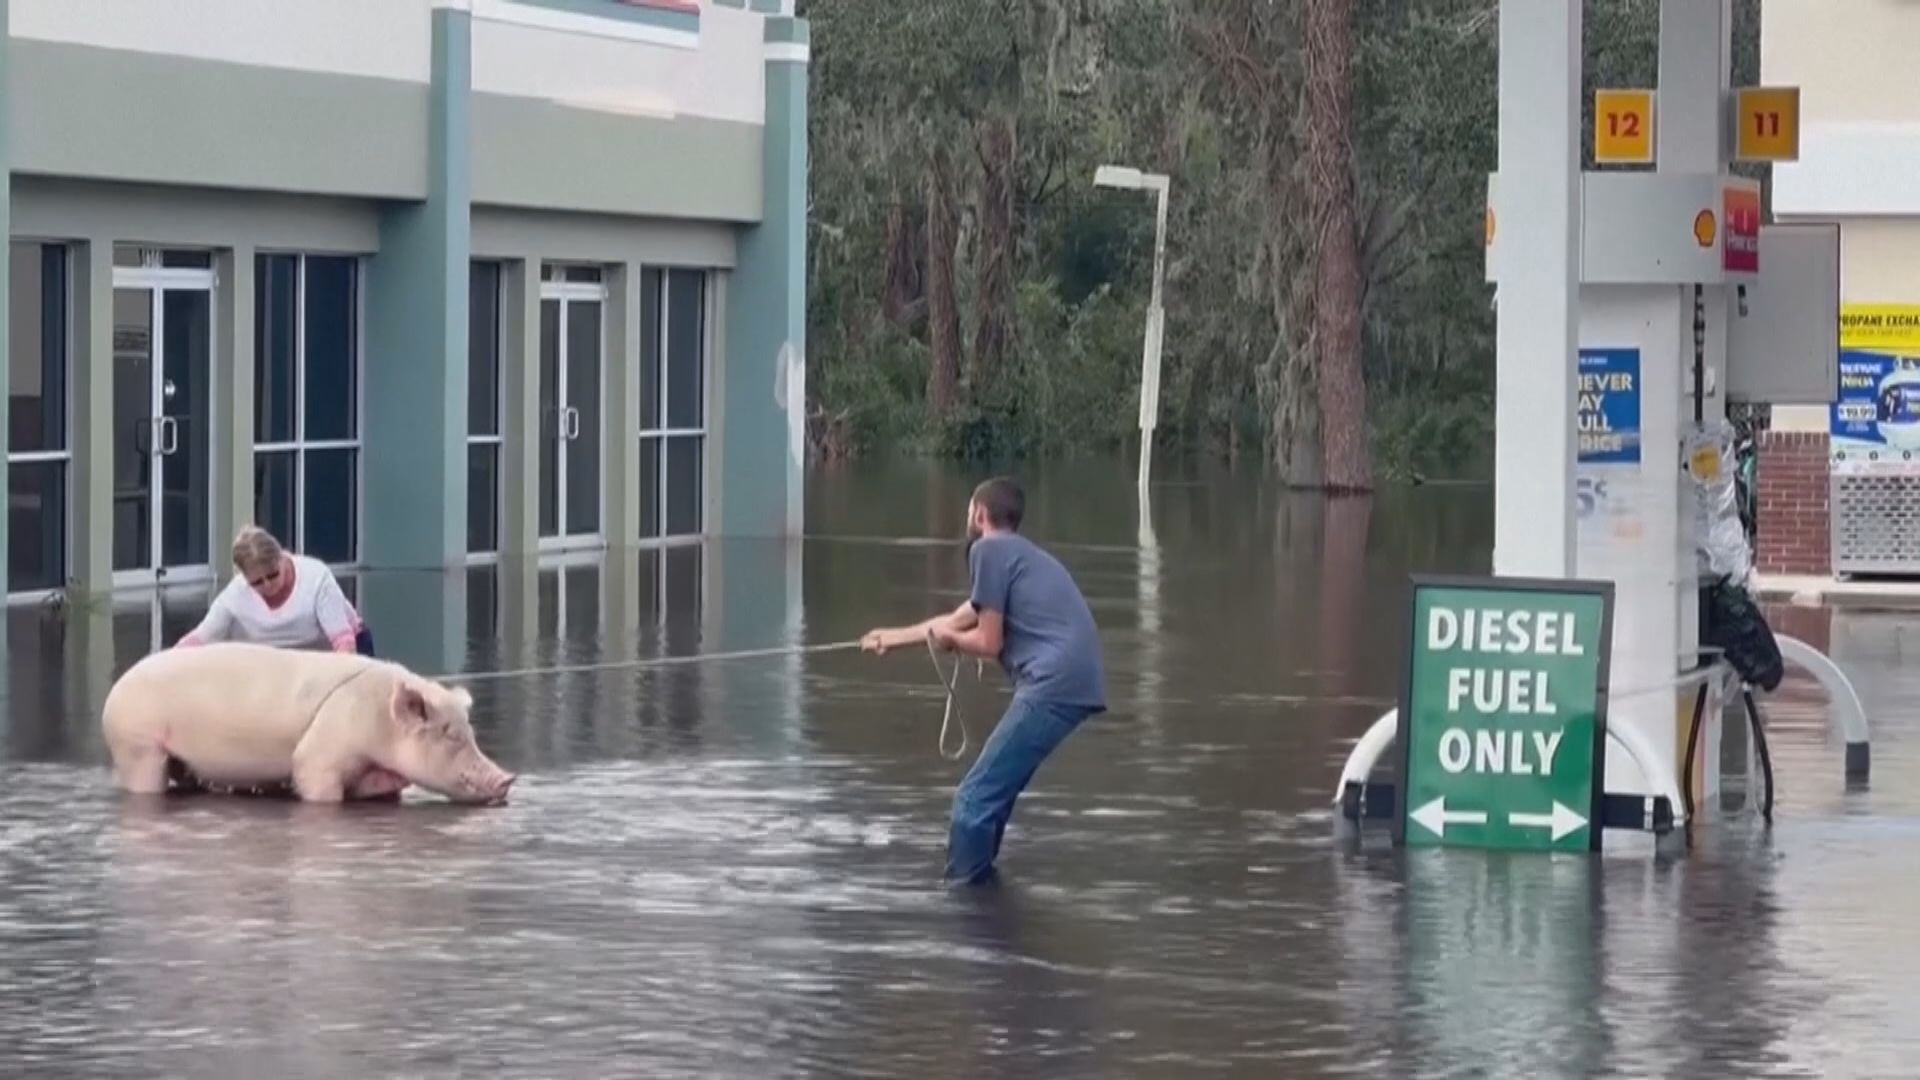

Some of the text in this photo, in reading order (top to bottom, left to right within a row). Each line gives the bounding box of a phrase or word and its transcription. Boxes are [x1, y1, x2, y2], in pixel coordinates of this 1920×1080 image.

[1607, 112, 1640, 137] 12
[1754, 112, 1780, 137] 11
[1579, 393, 1605, 411] AY
[1578, 412, 1613, 432] ULL
[1428, 606, 1585, 656] DIESEL
[1448, 667, 1558, 714] FUEL
[1438, 725, 1564, 776] ONLY
